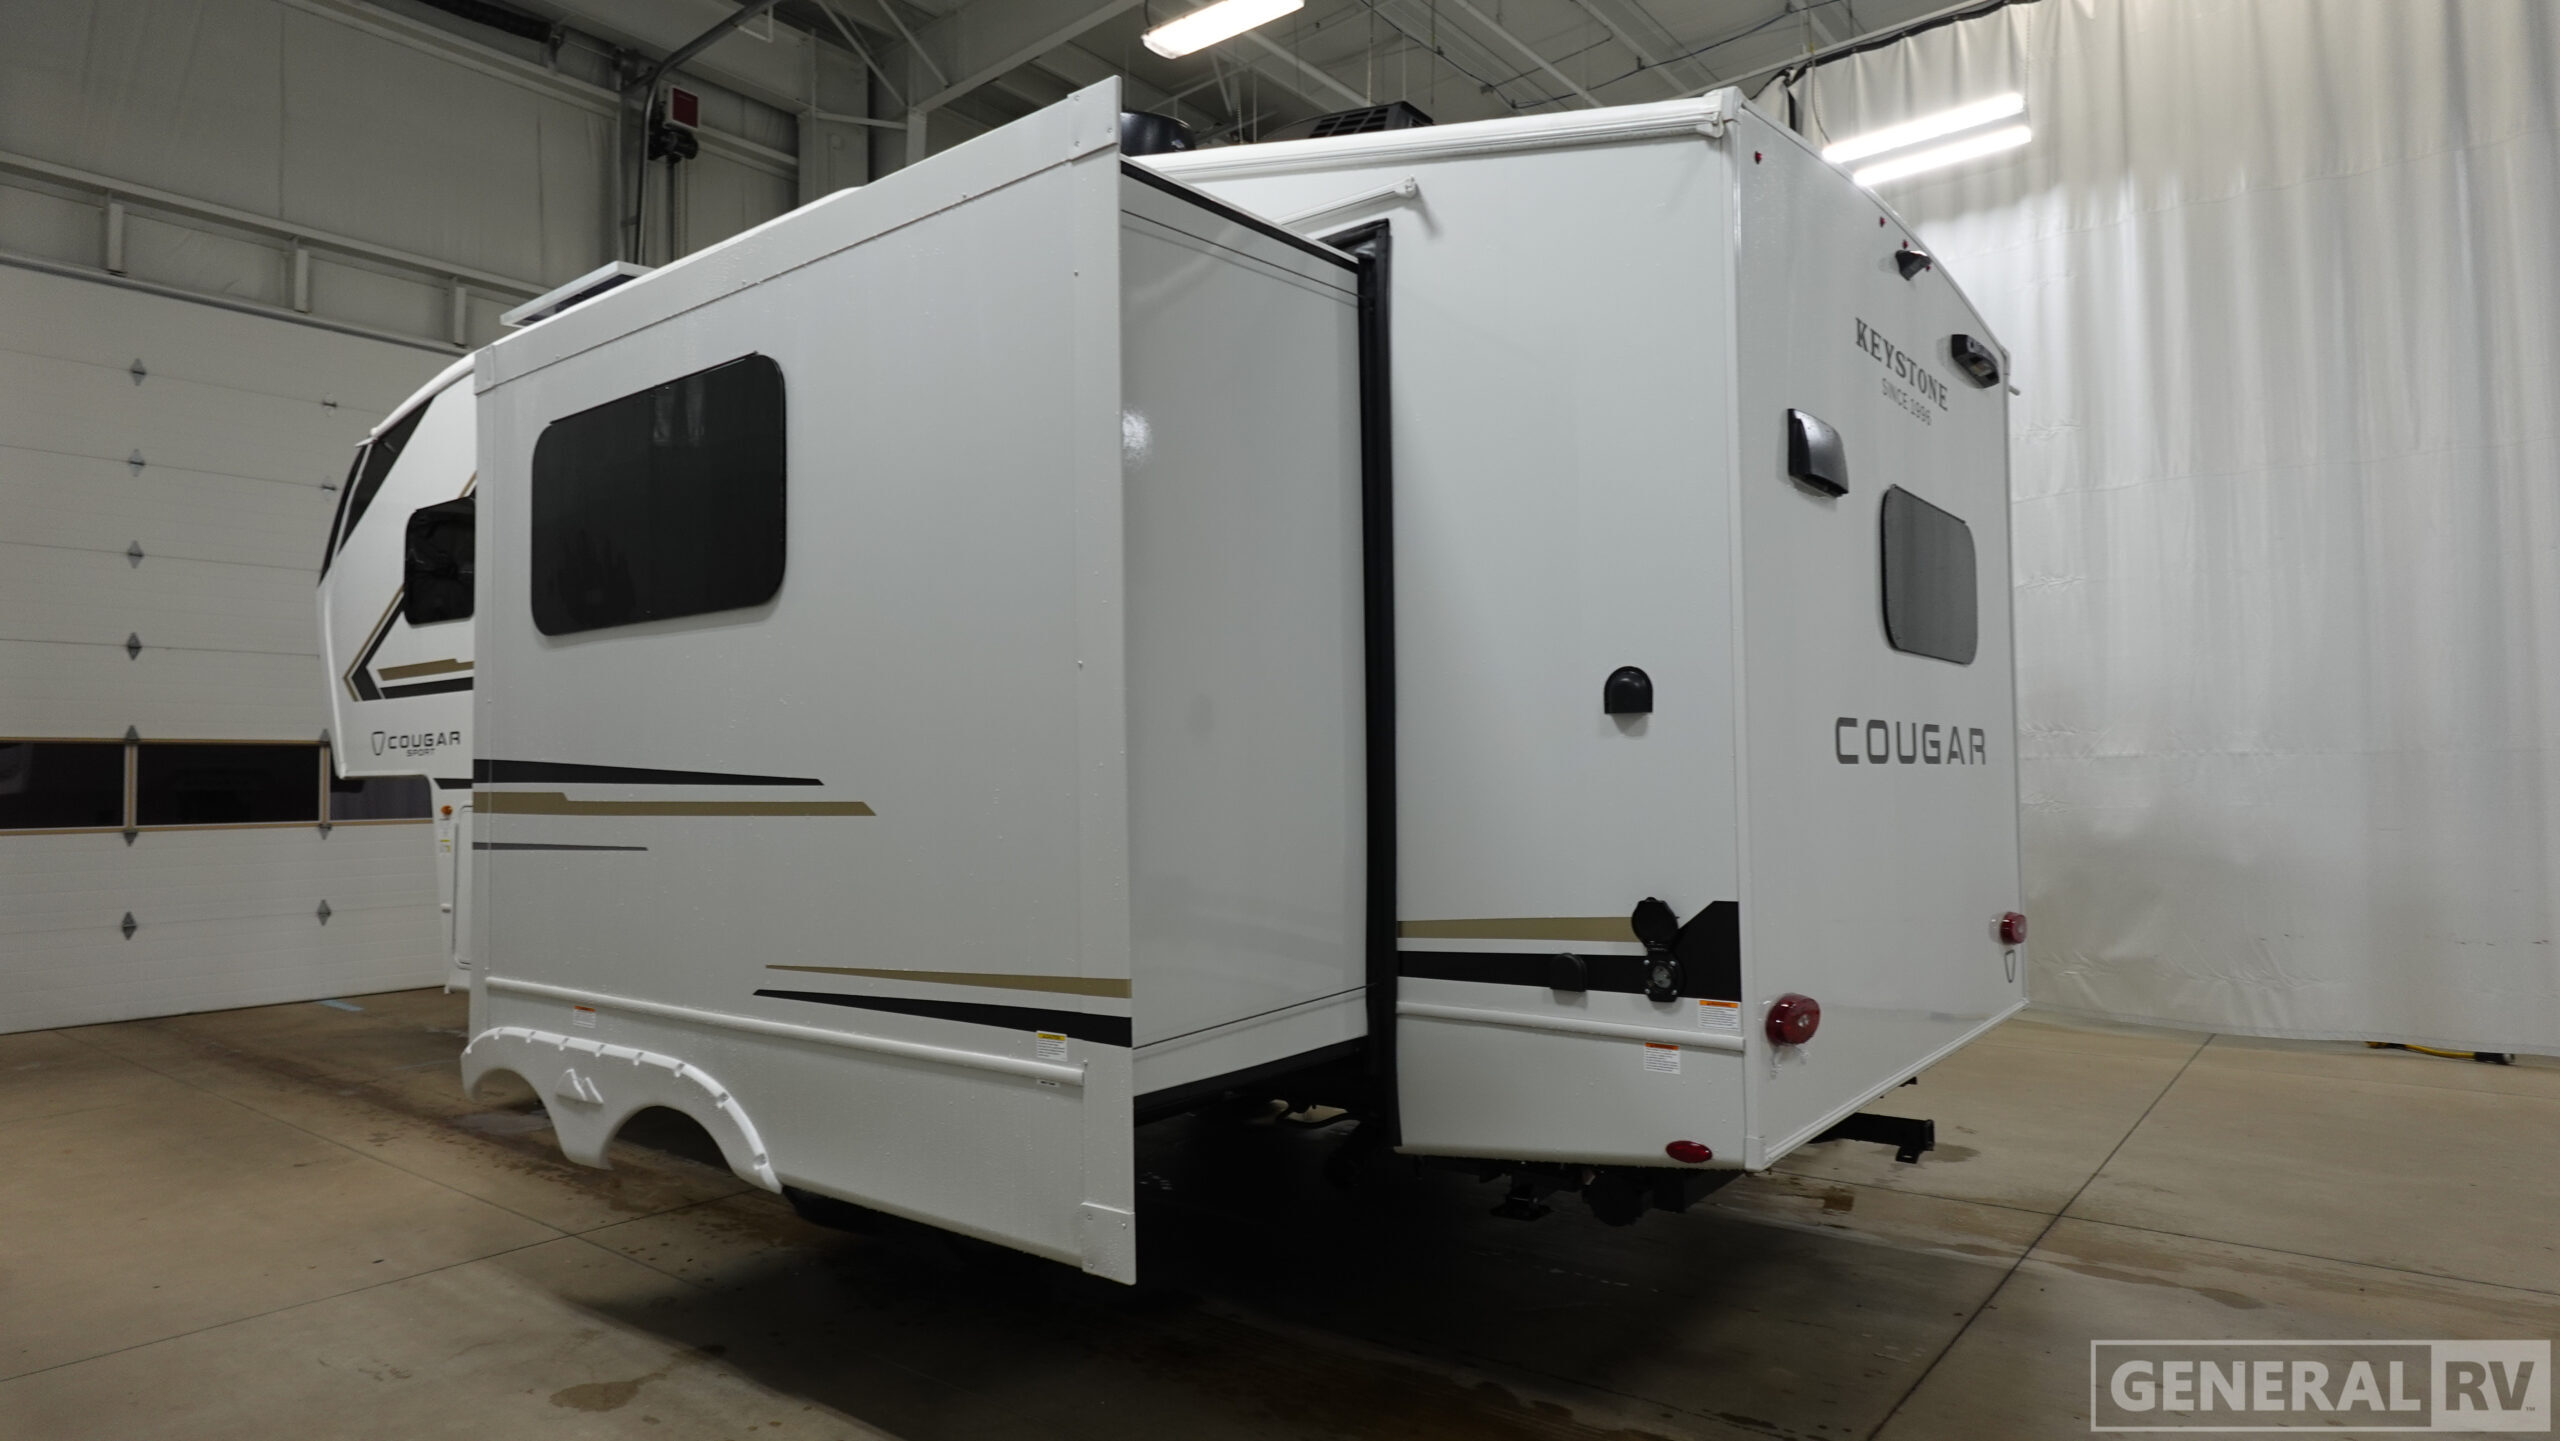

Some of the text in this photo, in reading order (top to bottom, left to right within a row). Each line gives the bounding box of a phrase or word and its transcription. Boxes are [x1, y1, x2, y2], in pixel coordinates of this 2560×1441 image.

[1855, 317, 1948, 411] KEYSTONE
[1882, 378, 1932, 426] SINCE 1996
[388, 731, 460, 749] COUGAR
[406, 748, 435, 757] SPORT
[1835, 716, 1986, 765] COUGAR
